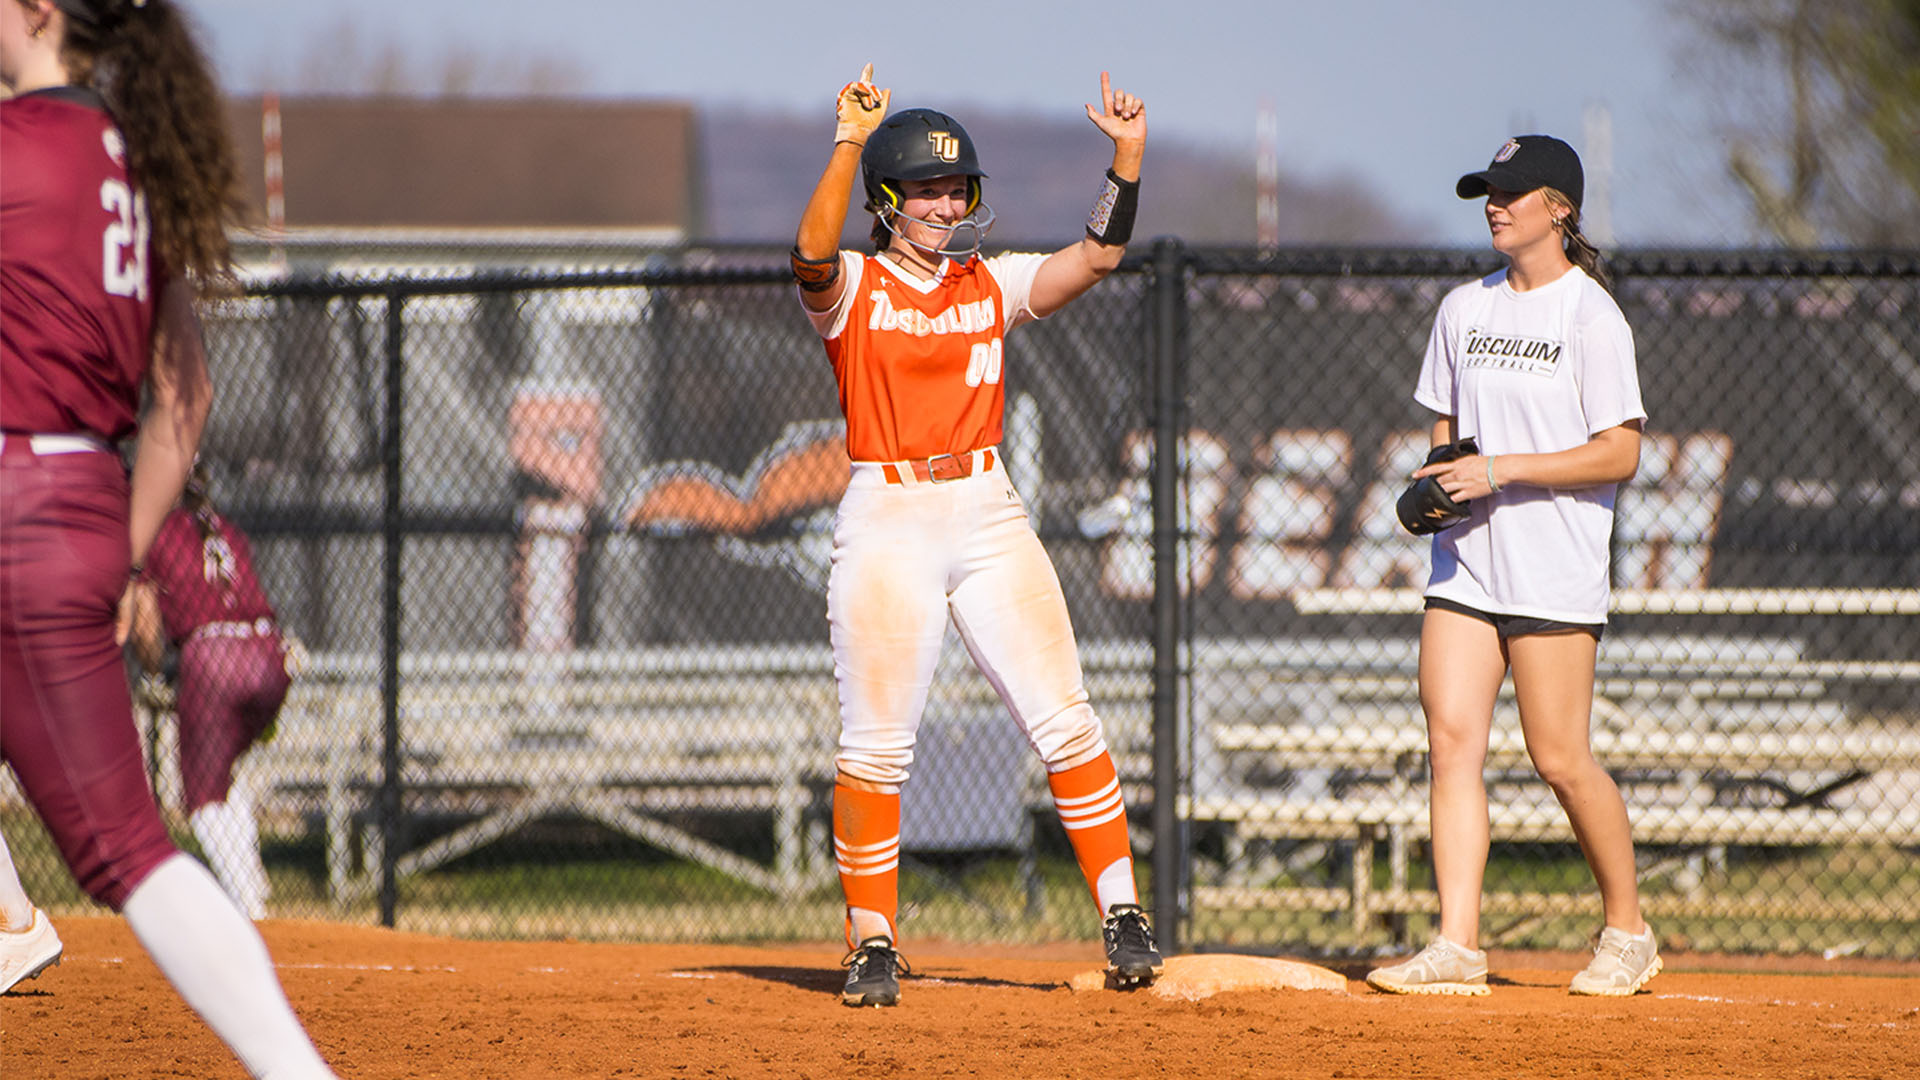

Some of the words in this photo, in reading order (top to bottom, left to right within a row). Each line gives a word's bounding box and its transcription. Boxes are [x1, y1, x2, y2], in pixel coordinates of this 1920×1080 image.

[928, 131, 960, 163] TU
[965, 337, 1002, 388] 00
[1466, 328, 1561, 364] USCULUM
